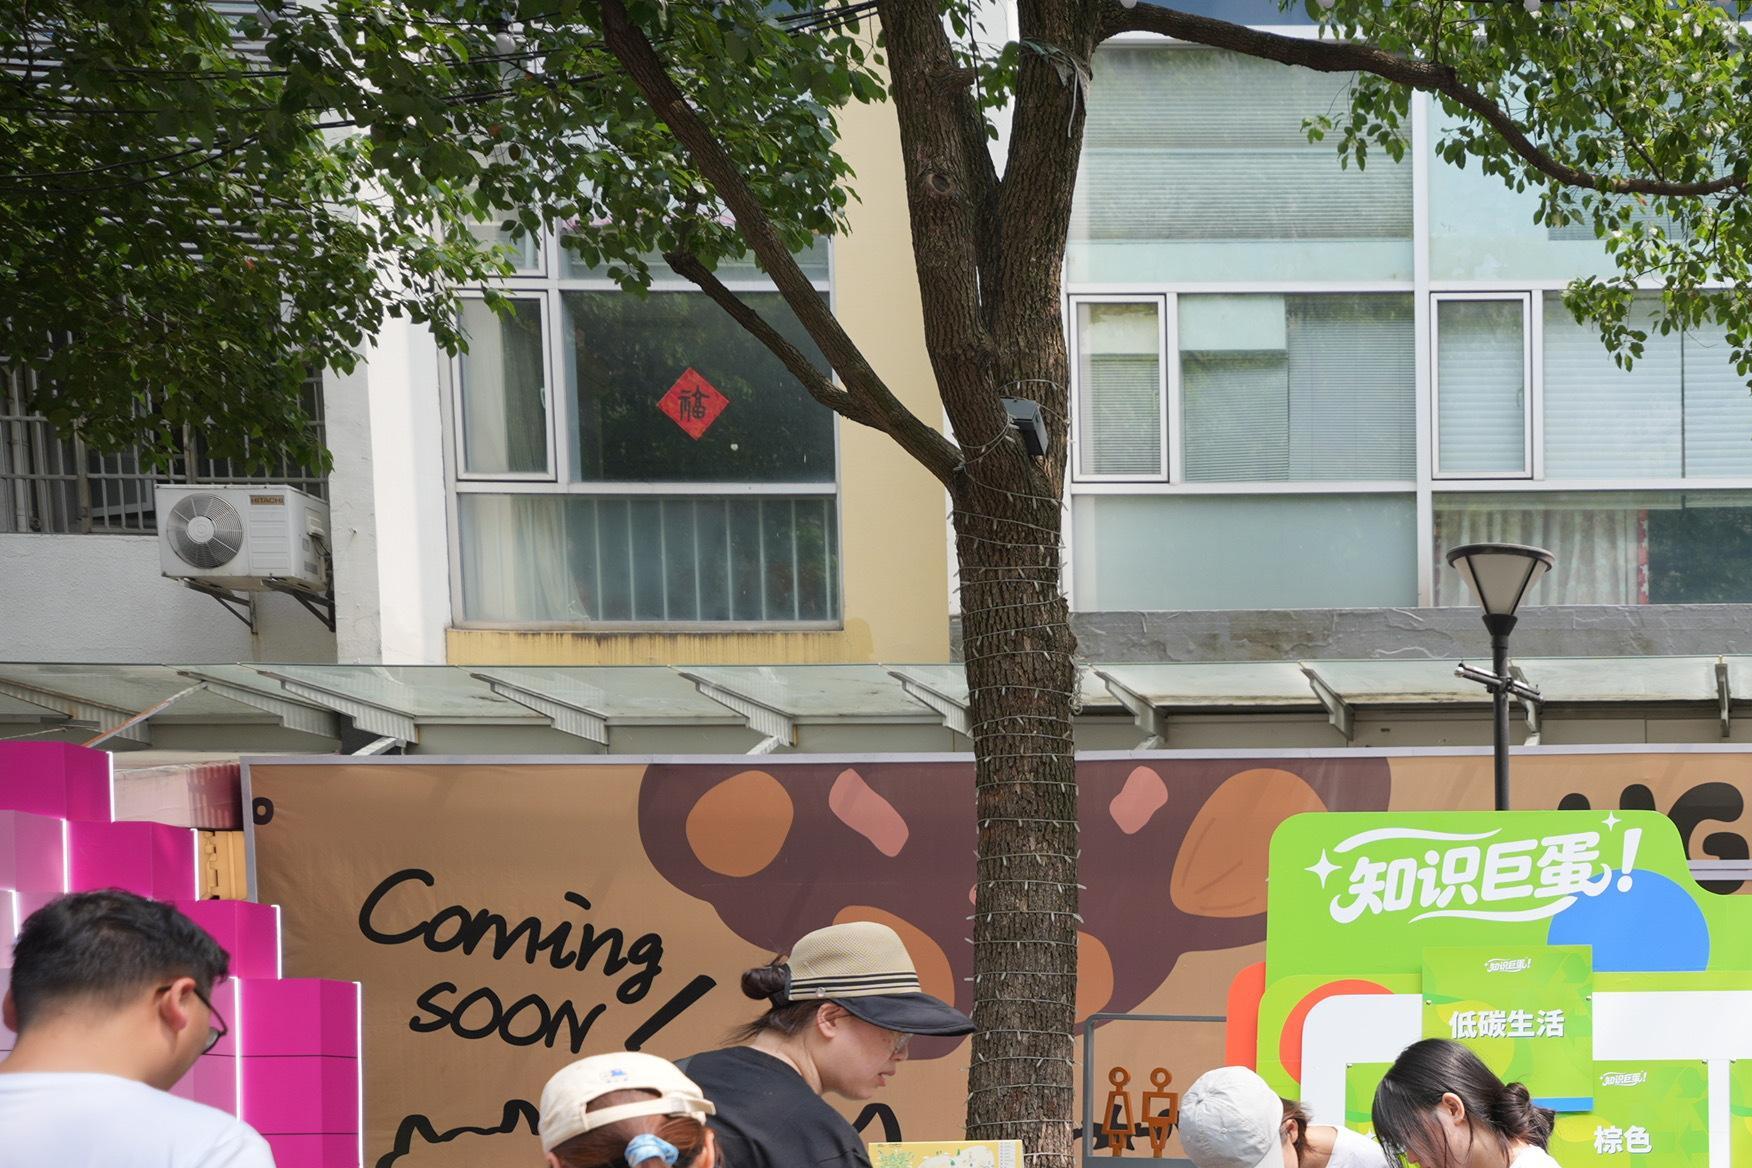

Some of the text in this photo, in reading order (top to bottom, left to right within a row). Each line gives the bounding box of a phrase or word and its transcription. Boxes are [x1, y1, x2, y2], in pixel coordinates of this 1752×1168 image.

[677, 385, 710, 422] 福
[1330, 828, 1642, 923] 知识巨蛋!
[359, 867, 663, 1004] Coming
[1449, 1009, 1565, 1039] 低碳生活
[1594, 1125, 1652, 1154] 棕色
